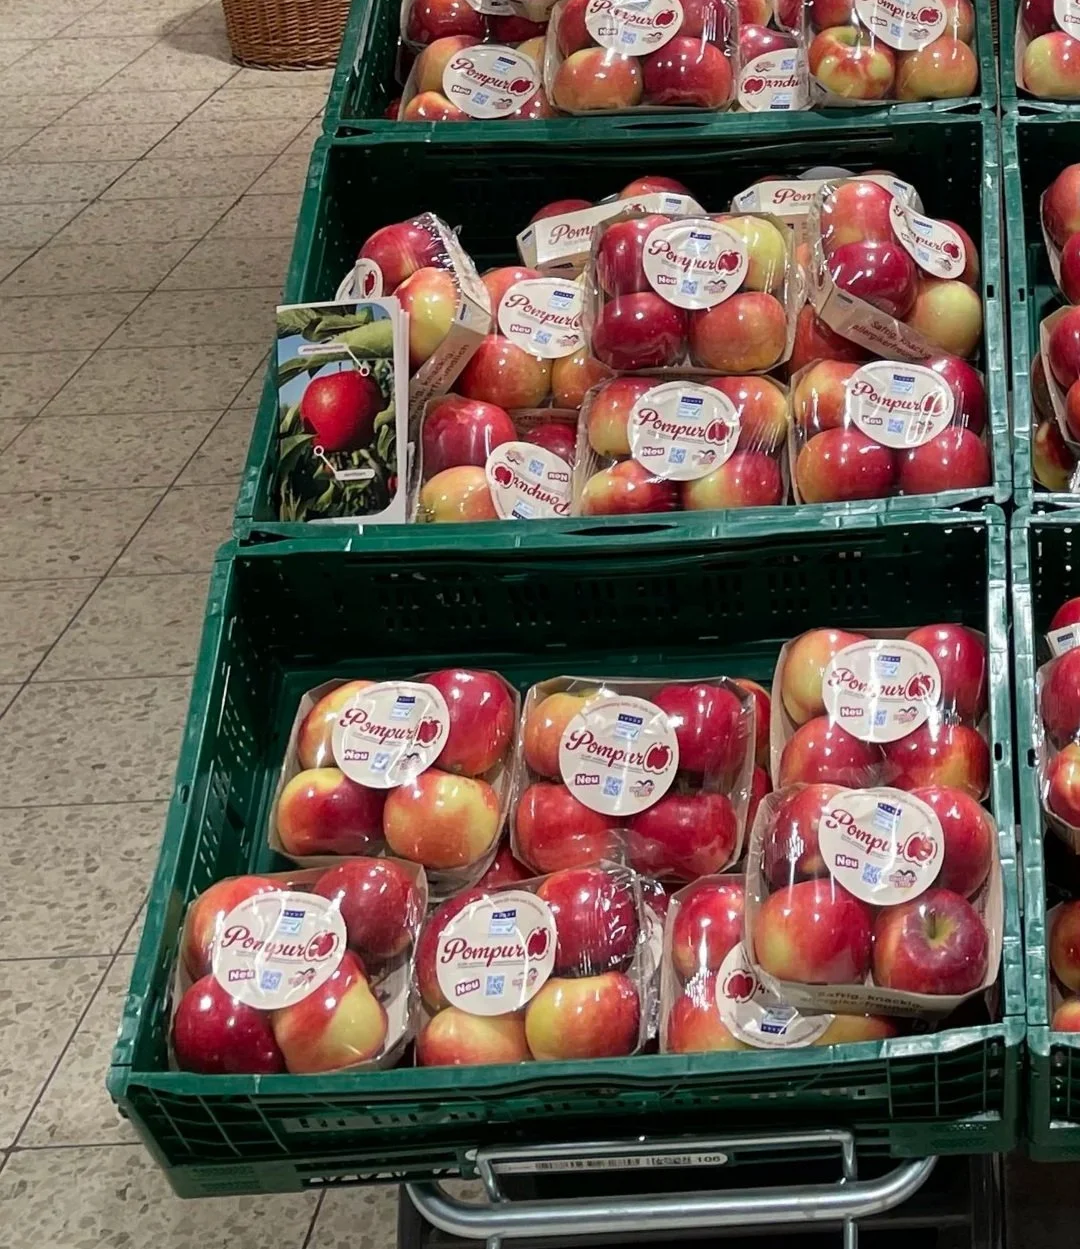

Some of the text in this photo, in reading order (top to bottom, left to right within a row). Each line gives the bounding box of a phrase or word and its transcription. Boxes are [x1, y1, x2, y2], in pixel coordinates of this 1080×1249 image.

[450, 57, 509, 91] Pompur
[505, 294, 572, 329] Pompur
[509, 323, 532, 336] Neu
[851, 380, 921, 412] Pompur
[638, 408, 706, 440] Pompur
[642, 446, 665, 457] Neu
[513, 476, 571, 517] Pompur
[340, 708, 416, 745] Pompur
[840, 706, 864, 718] Neu
[565, 730, 645, 768] Pompur
[574, 772, 600, 786] Neu
[835, 853, 858, 870] Neu
[221, 924, 306, 962] Pompur
[441, 937, 528, 968] Pompur
[228, 968, 255, 982] Neu
[454, 978, 481, 996] Neu
